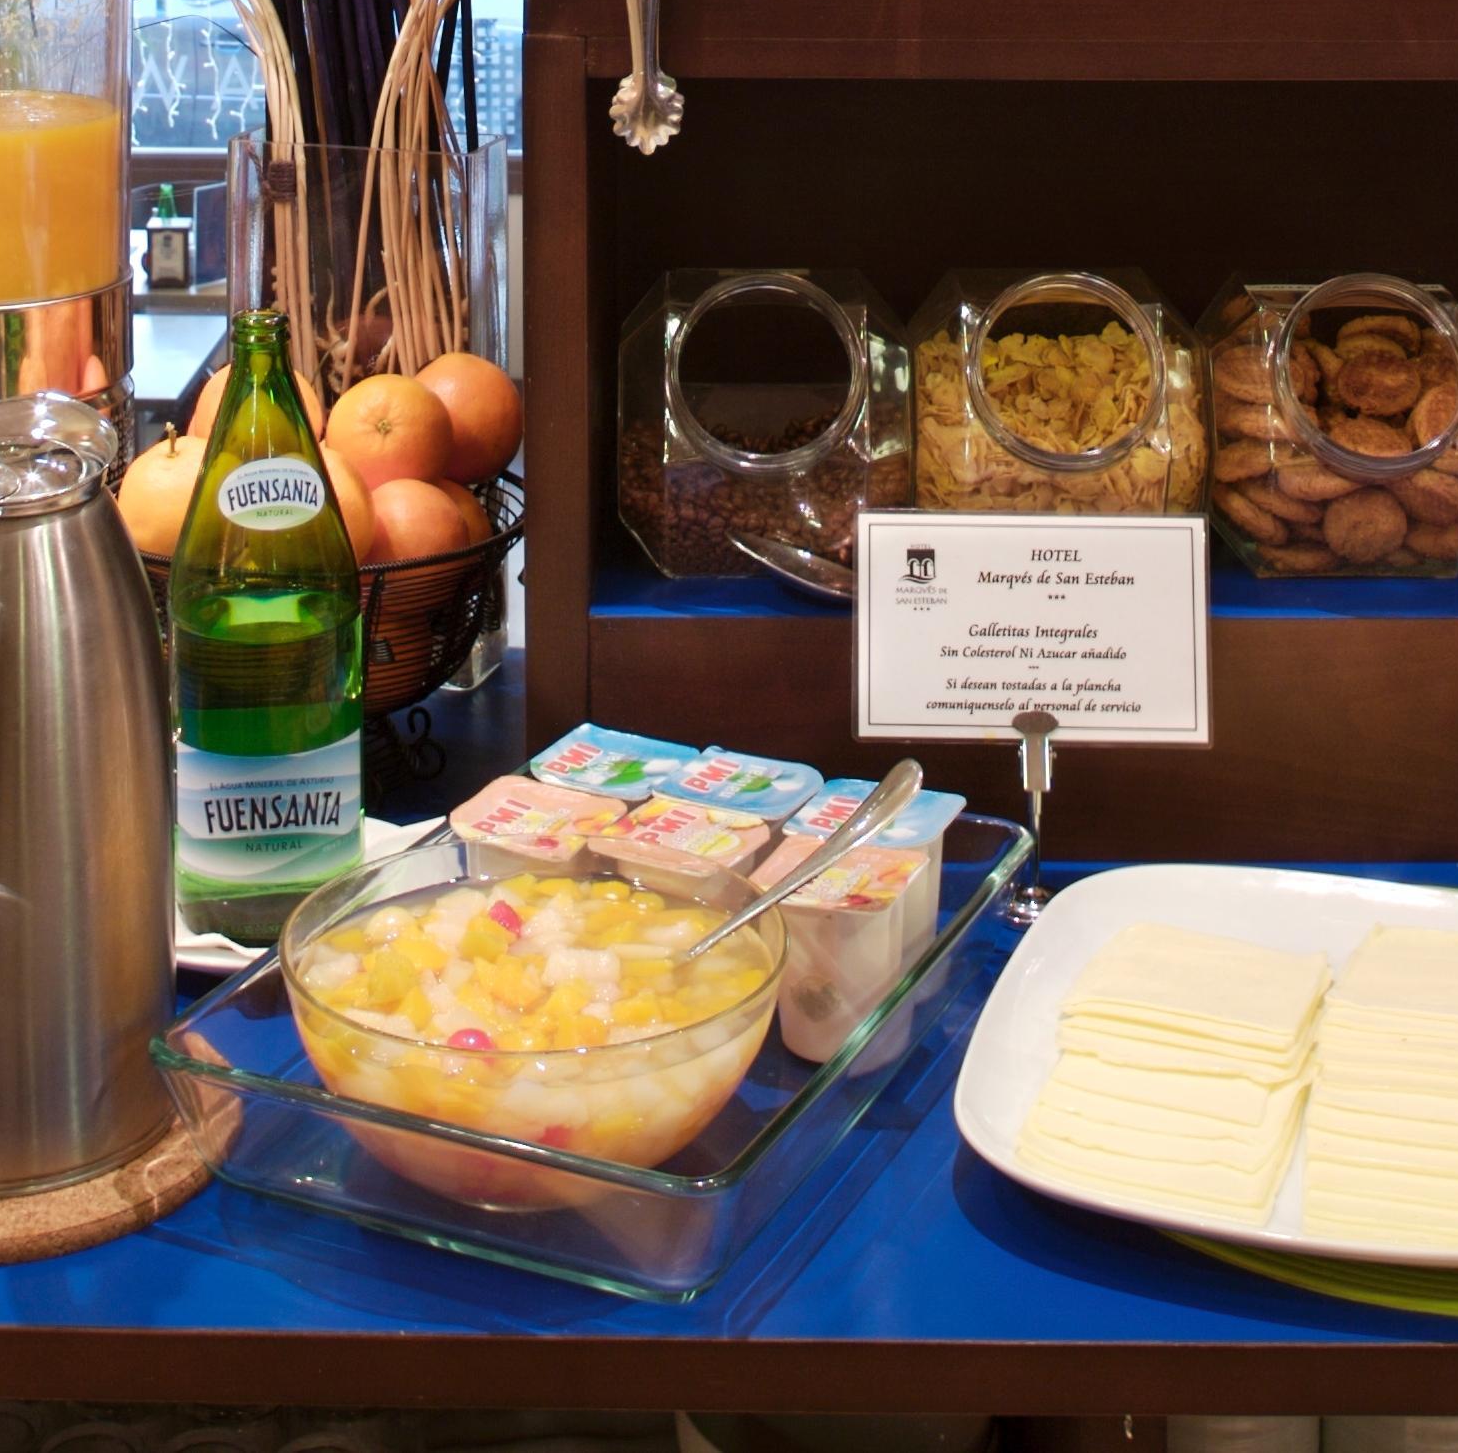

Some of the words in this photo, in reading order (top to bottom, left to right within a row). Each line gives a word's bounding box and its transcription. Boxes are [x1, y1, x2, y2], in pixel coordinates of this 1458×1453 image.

[227, 478, 318, 511] FUENSANTA
[256, 509, 294, 518] NATURAL
[1031, 548, 1082, 563] HOTEL
[1037, 570, 1051, 585] de
[1055, 572, 1080, 586] San
[1085, 570, 1135, 587] Esteban
[895, 597, 912, 605] SAN
[913, 596, 948, 605] ESTEBAN
[968, 622, 1031, 639] Galletitas
[1036, 623, 1098, 644] Integrales
[940, 646, 958, 658] Sin
[962, 644, 1016, 659] Colesterol
[1019, 646, 1034, 659] Ni
[1037, 646, 1077, 659] Azucar
[1080, 646, 1127, 660] añadido
[945, 678, 958, 690] Si
[960, 677, 998, 691] desean
[1001, 678, 1047, 691] tostadas
[1061, 677, 1073, 691] la
[1074, 679, 1122, 696] plancha
[925, 698, 1015, 713] comuniquenselo
[1018, 698, 1031, 711] al
[1033, 699, 1081, 714] personal
[1084, 699, 1097, 712] de
[1100, 700, 1142, 713] servicio
[544, 742, 602, 775] PMI
[683, 757, 741, 793] PMI
[204, 791, 342, 835] FUENSANTA
[471, 798, 532, 835] PMI
[807, 796, 861, 831] PMI
[634, 809, 697, 845] PMI
[245, 839, 304, 853] NATURAL
